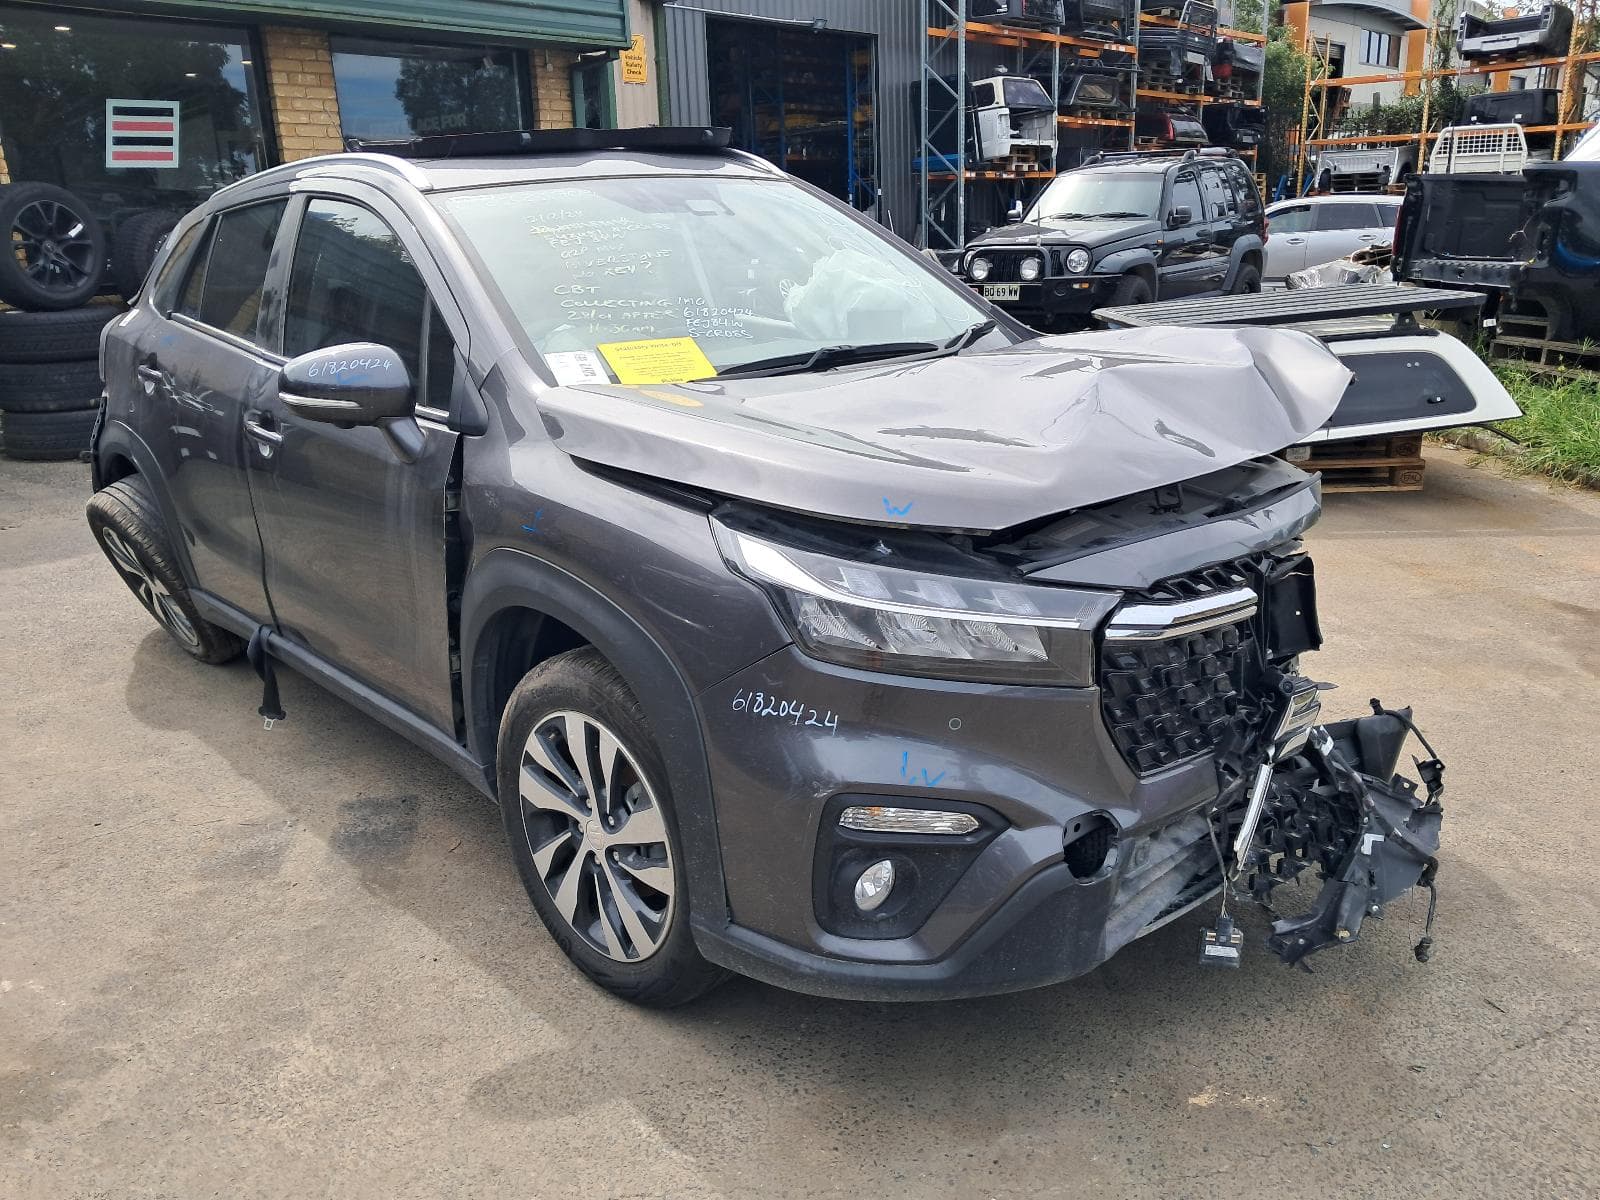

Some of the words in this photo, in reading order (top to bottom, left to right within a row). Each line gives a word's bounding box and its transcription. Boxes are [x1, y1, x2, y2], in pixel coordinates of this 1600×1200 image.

[625, 61, 643, 69] Safety
[554, 284, 600, 295] CBT
[997, 287, 1005, 296] 69
[683, 307, 754, 318] 61820424
[689, 328, 754, 339] S-CROSS
[308, 359, 393, 377] 61820424
[732, 688, 839, 736] 61820424
